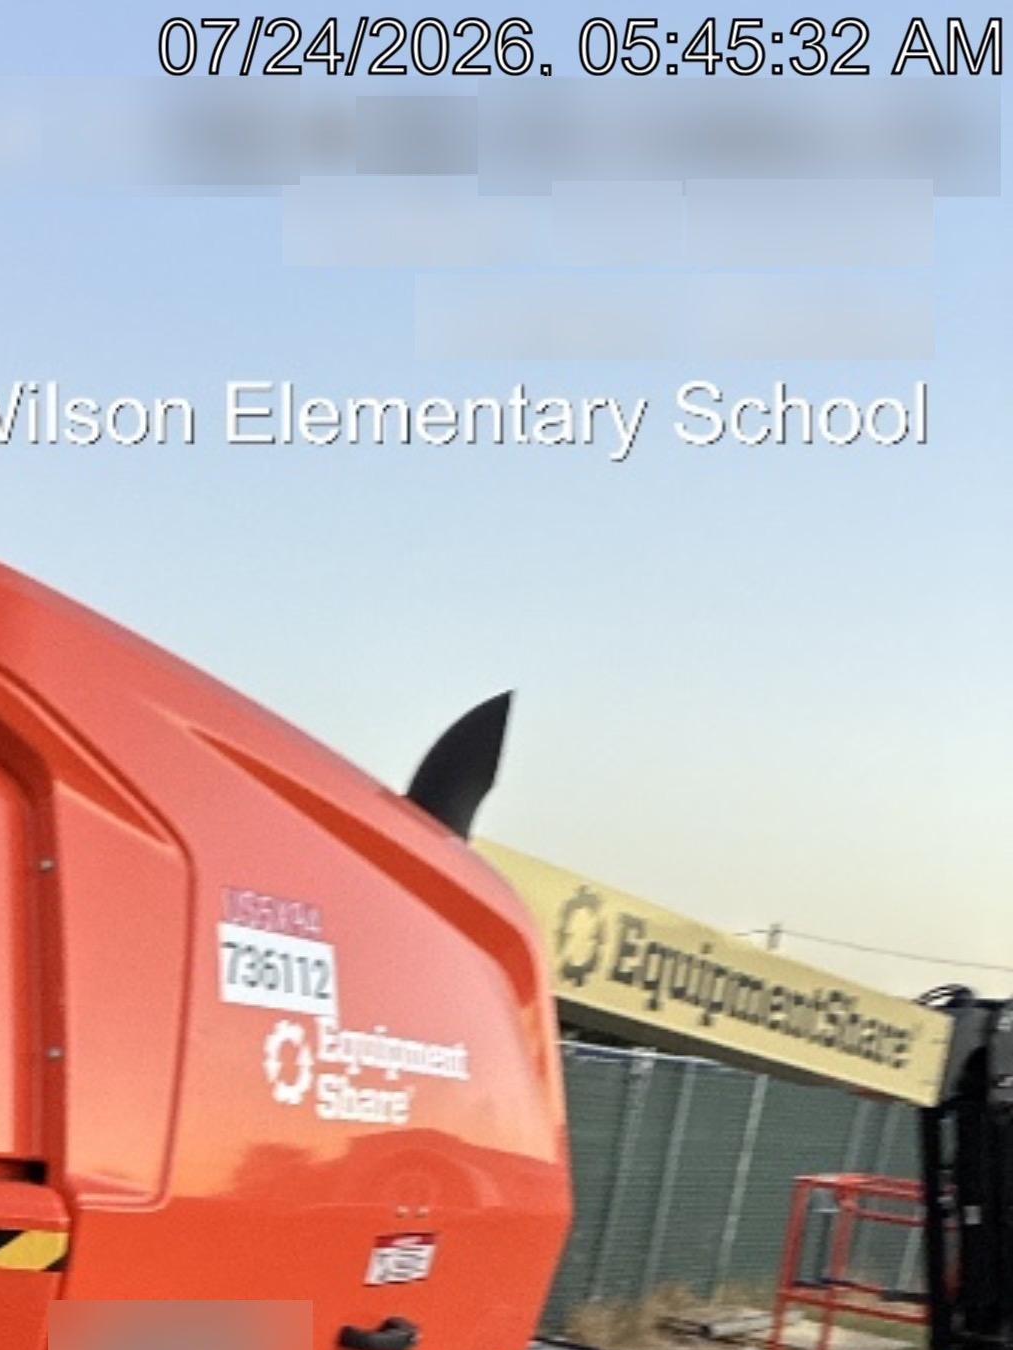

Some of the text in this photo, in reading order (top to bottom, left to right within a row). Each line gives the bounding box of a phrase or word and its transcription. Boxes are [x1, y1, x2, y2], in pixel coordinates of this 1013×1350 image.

[220, 940, 332, 1000] 736112
[316, 1016, 470, 1081] Equipment
[316, 1073, 412, 1125] Share
